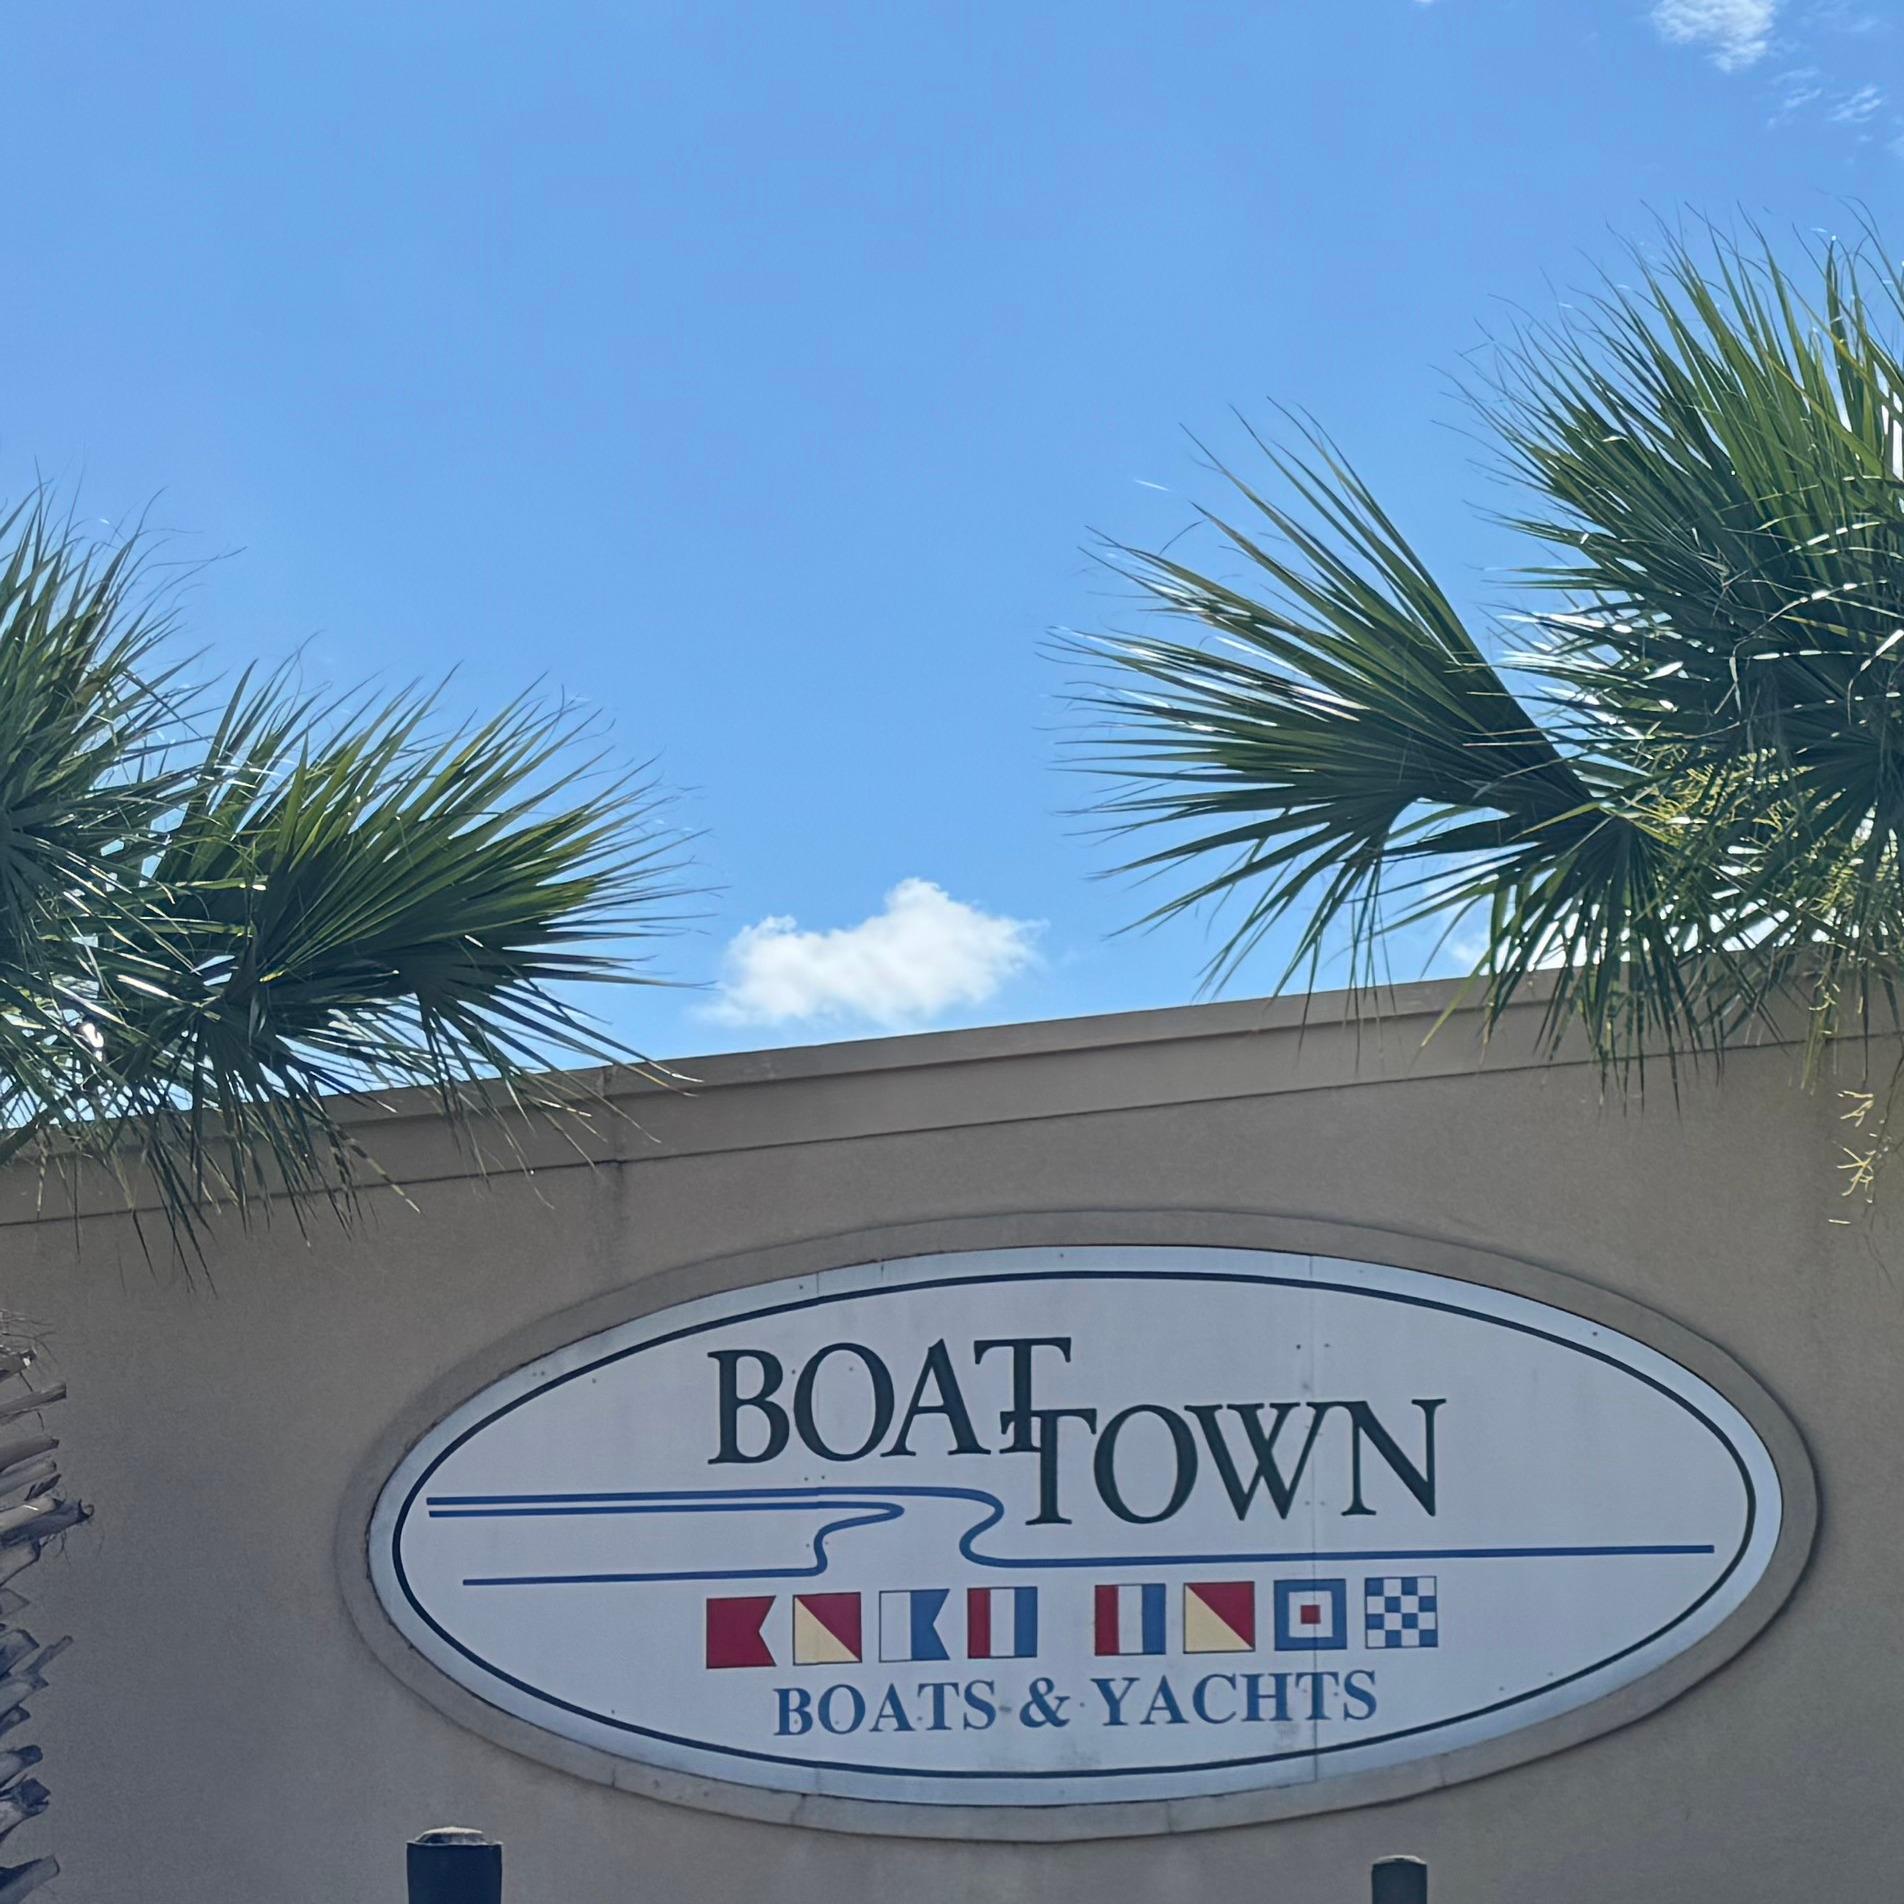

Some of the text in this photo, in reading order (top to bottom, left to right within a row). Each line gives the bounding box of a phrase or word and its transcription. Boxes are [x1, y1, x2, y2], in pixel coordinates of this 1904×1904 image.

[707, 1337, 1072, 1466] BOAT
[1000, 1398, 1447, 1526] TOWN
[773, 1669, 1379, 1737] BOATS & YACHTS
